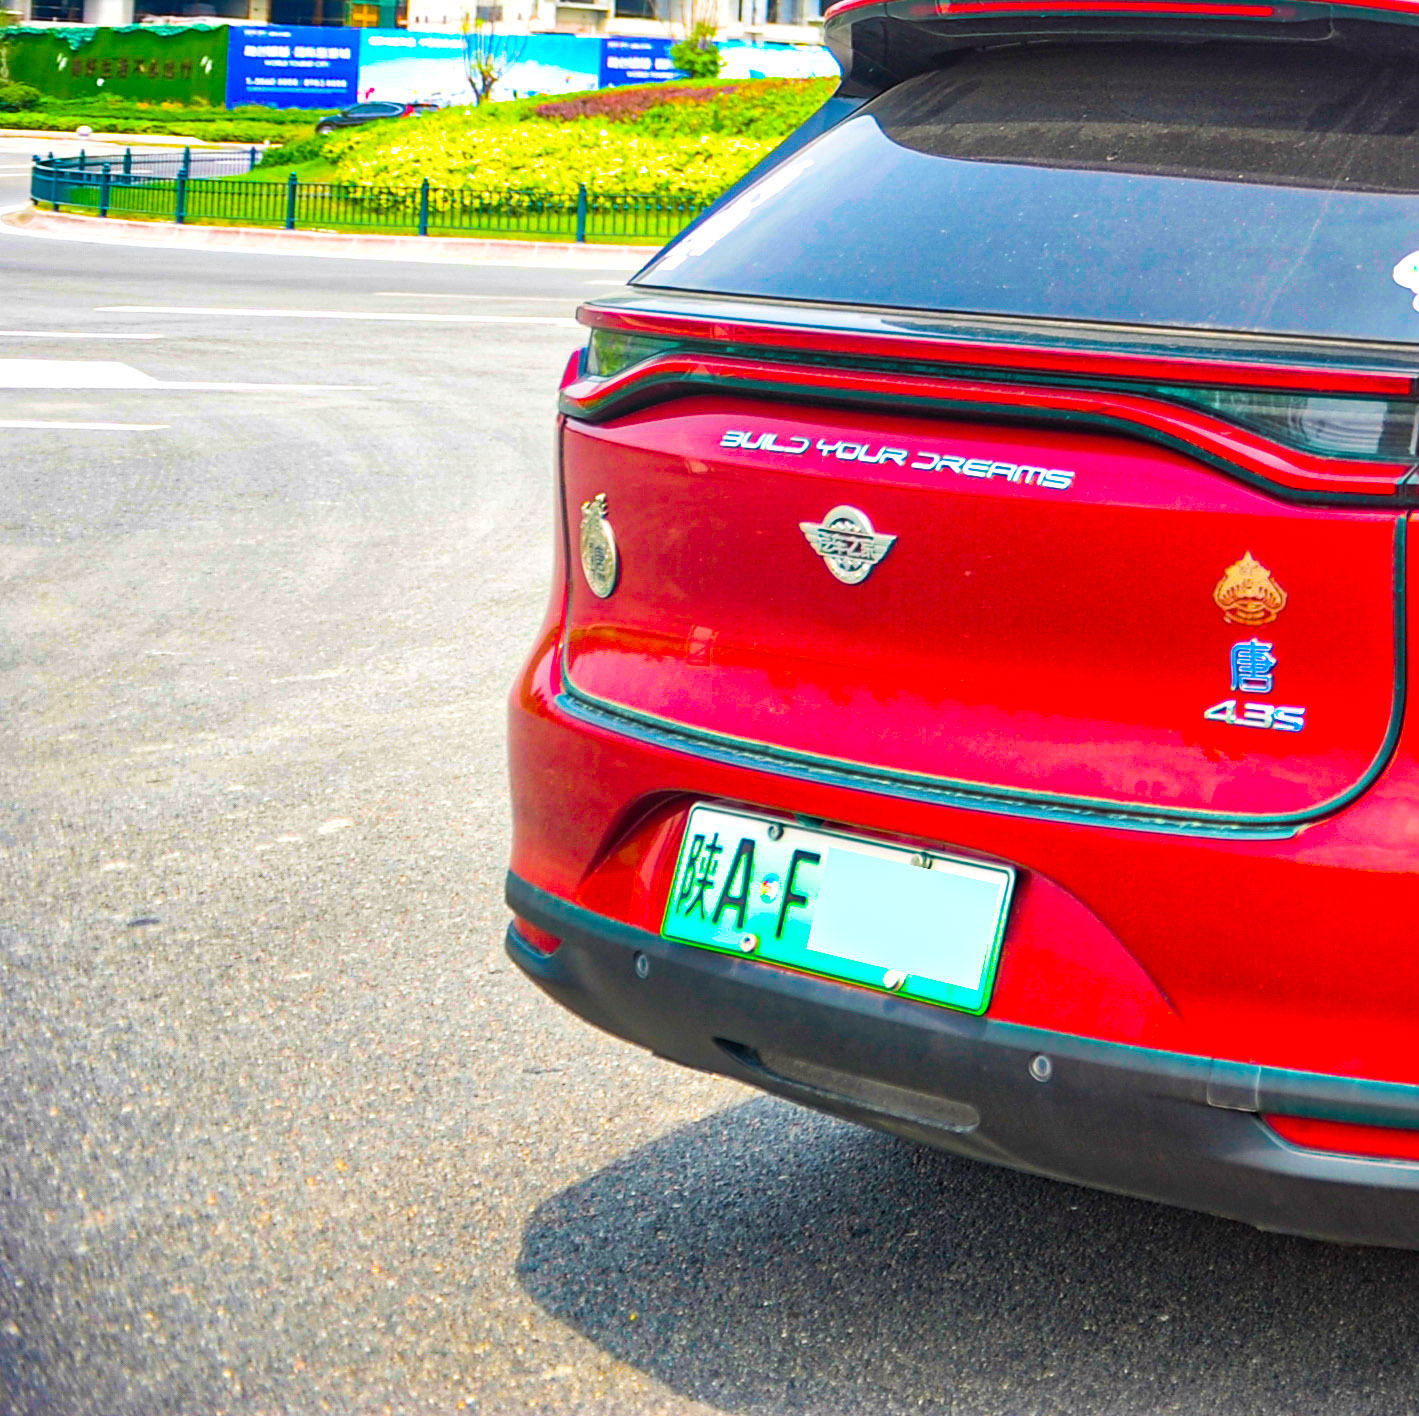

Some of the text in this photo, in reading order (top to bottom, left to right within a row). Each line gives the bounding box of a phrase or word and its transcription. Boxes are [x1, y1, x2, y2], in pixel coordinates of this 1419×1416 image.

[719, 430, 1076, 491] BUILD YOUR DREAMS
[1230, 637, 1278, 694] 唐
